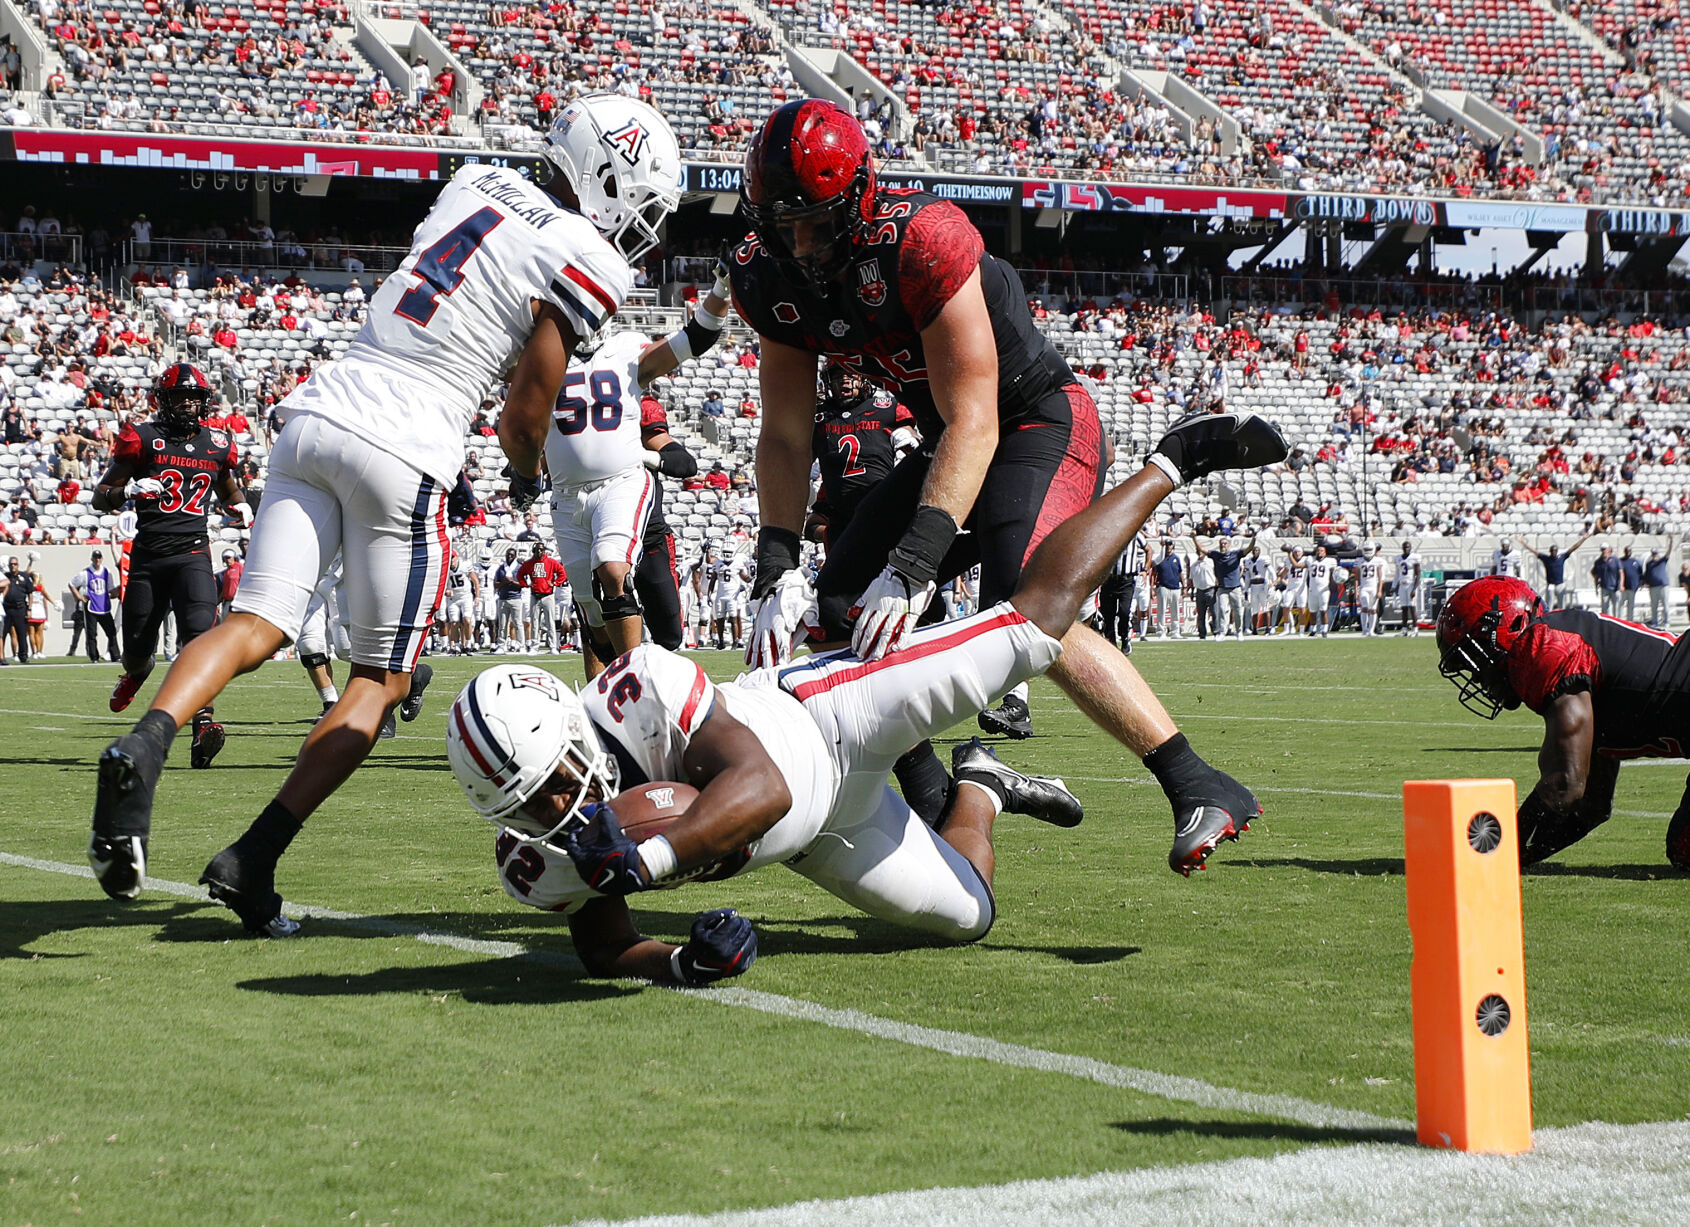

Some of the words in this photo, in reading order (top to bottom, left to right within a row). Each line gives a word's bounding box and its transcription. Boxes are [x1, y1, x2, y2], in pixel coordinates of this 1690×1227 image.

[601, 117, 650, 167] A
[700, 168, 741, 190] 13:04
[932, 183, 1014, 200] #THETIMEISNOW
[1306, 195, 1367, 219] THIRD
[1376, 199, 1429, 222] DOWN
[1608, 208, 1671, 232] THIRD
[394, 205, 505, 328] 4
[554, 369, 623, 436] 58
[856, 420, 881, 431] STATE
[170, 455, 198, 468] DIEGO
[838, 434, 866, 478] 2
[159, 468, 212, 516] 32
[723, 568, 731, 583] 6
